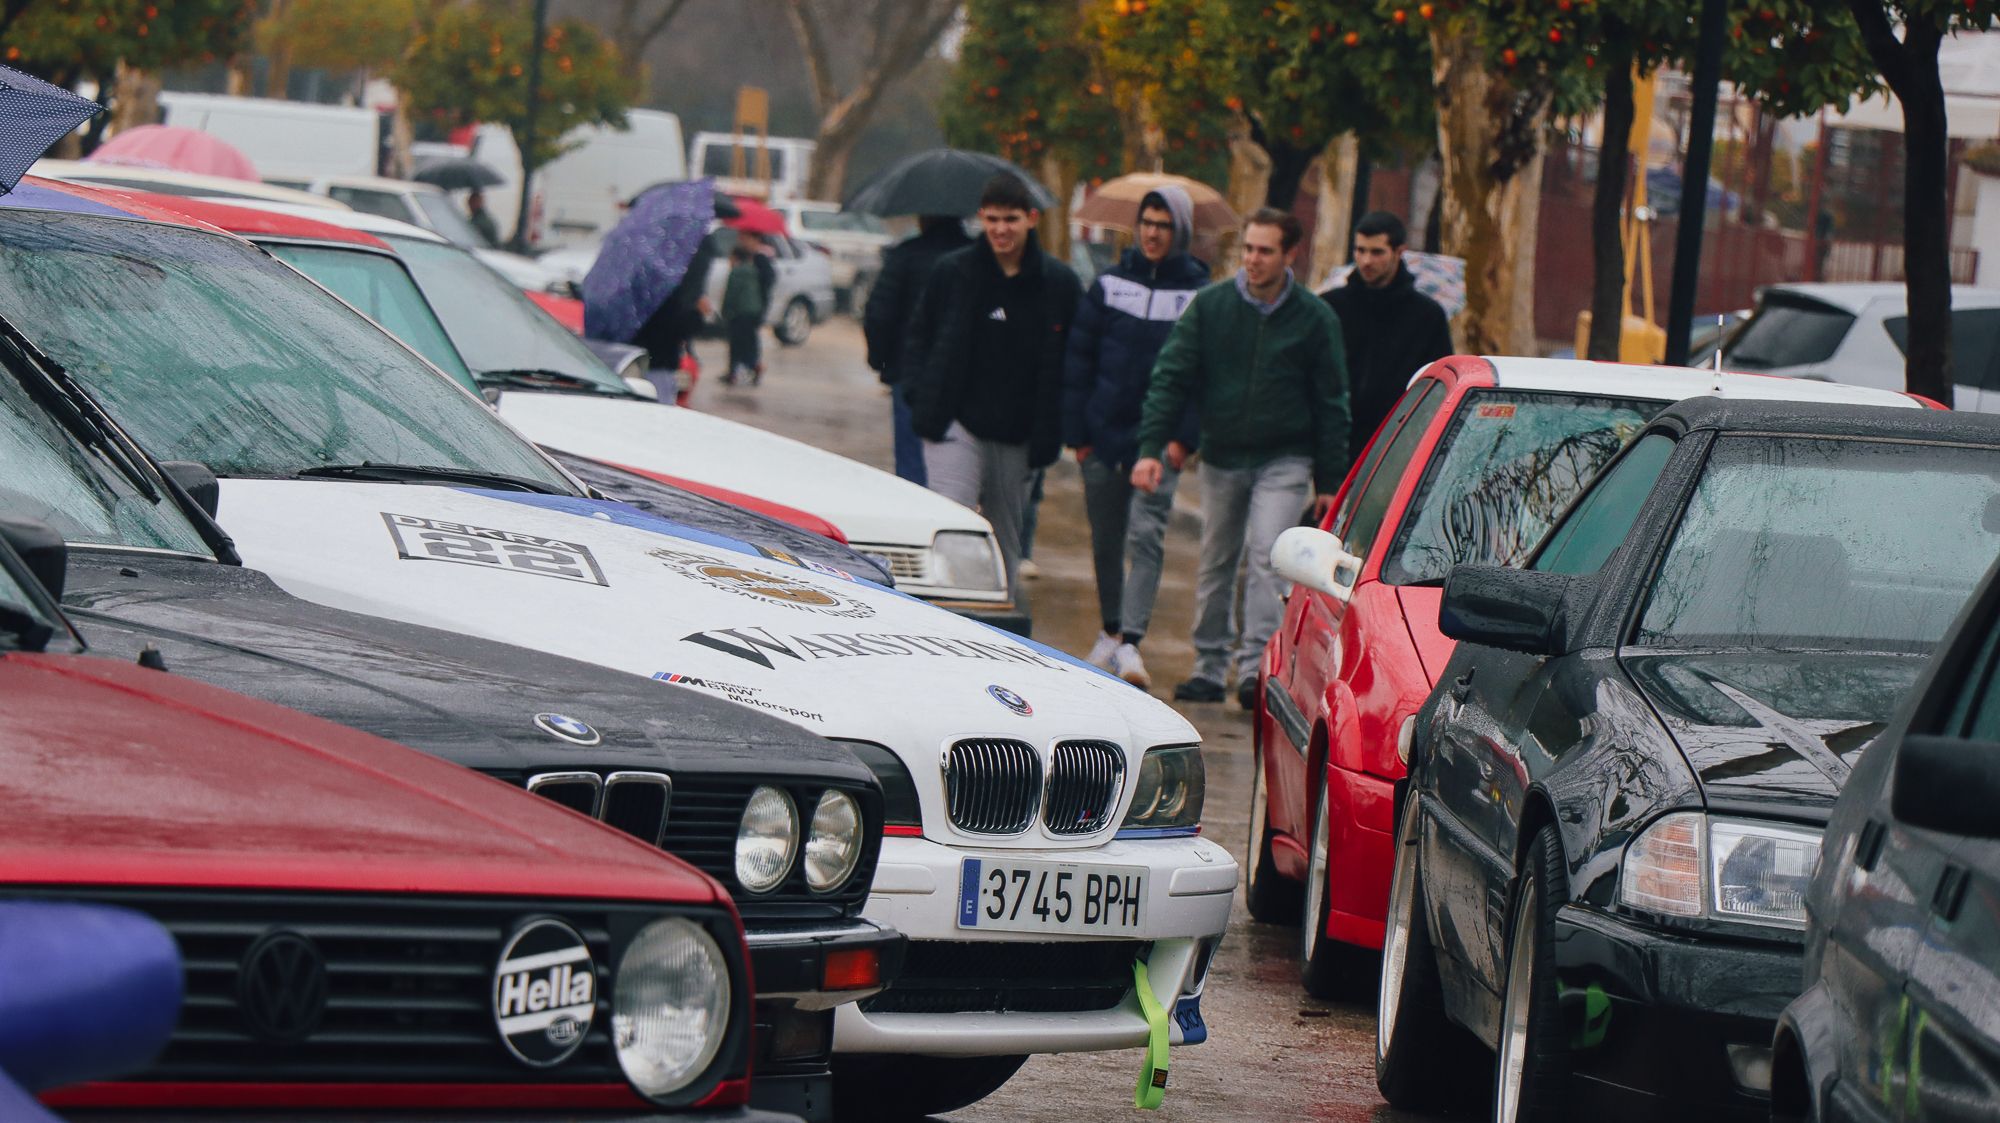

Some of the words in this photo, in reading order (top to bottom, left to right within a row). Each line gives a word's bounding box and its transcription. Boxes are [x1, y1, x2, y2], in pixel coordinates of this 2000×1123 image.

[390, 513, 583, 554] DEKRA
[419, 532, 584, 578] 22
[679, 626, 1070, 673] WARSTEINE
[707, 682, 753, 697] BMW
[727, 693, 825, 722] Motorsport
[965, 899, 974, 914] E
[986, 868, 1073, 923] 3745
[1084, 873, 1142, 926] BPH
[500, 964, 593, 1017] Hella
